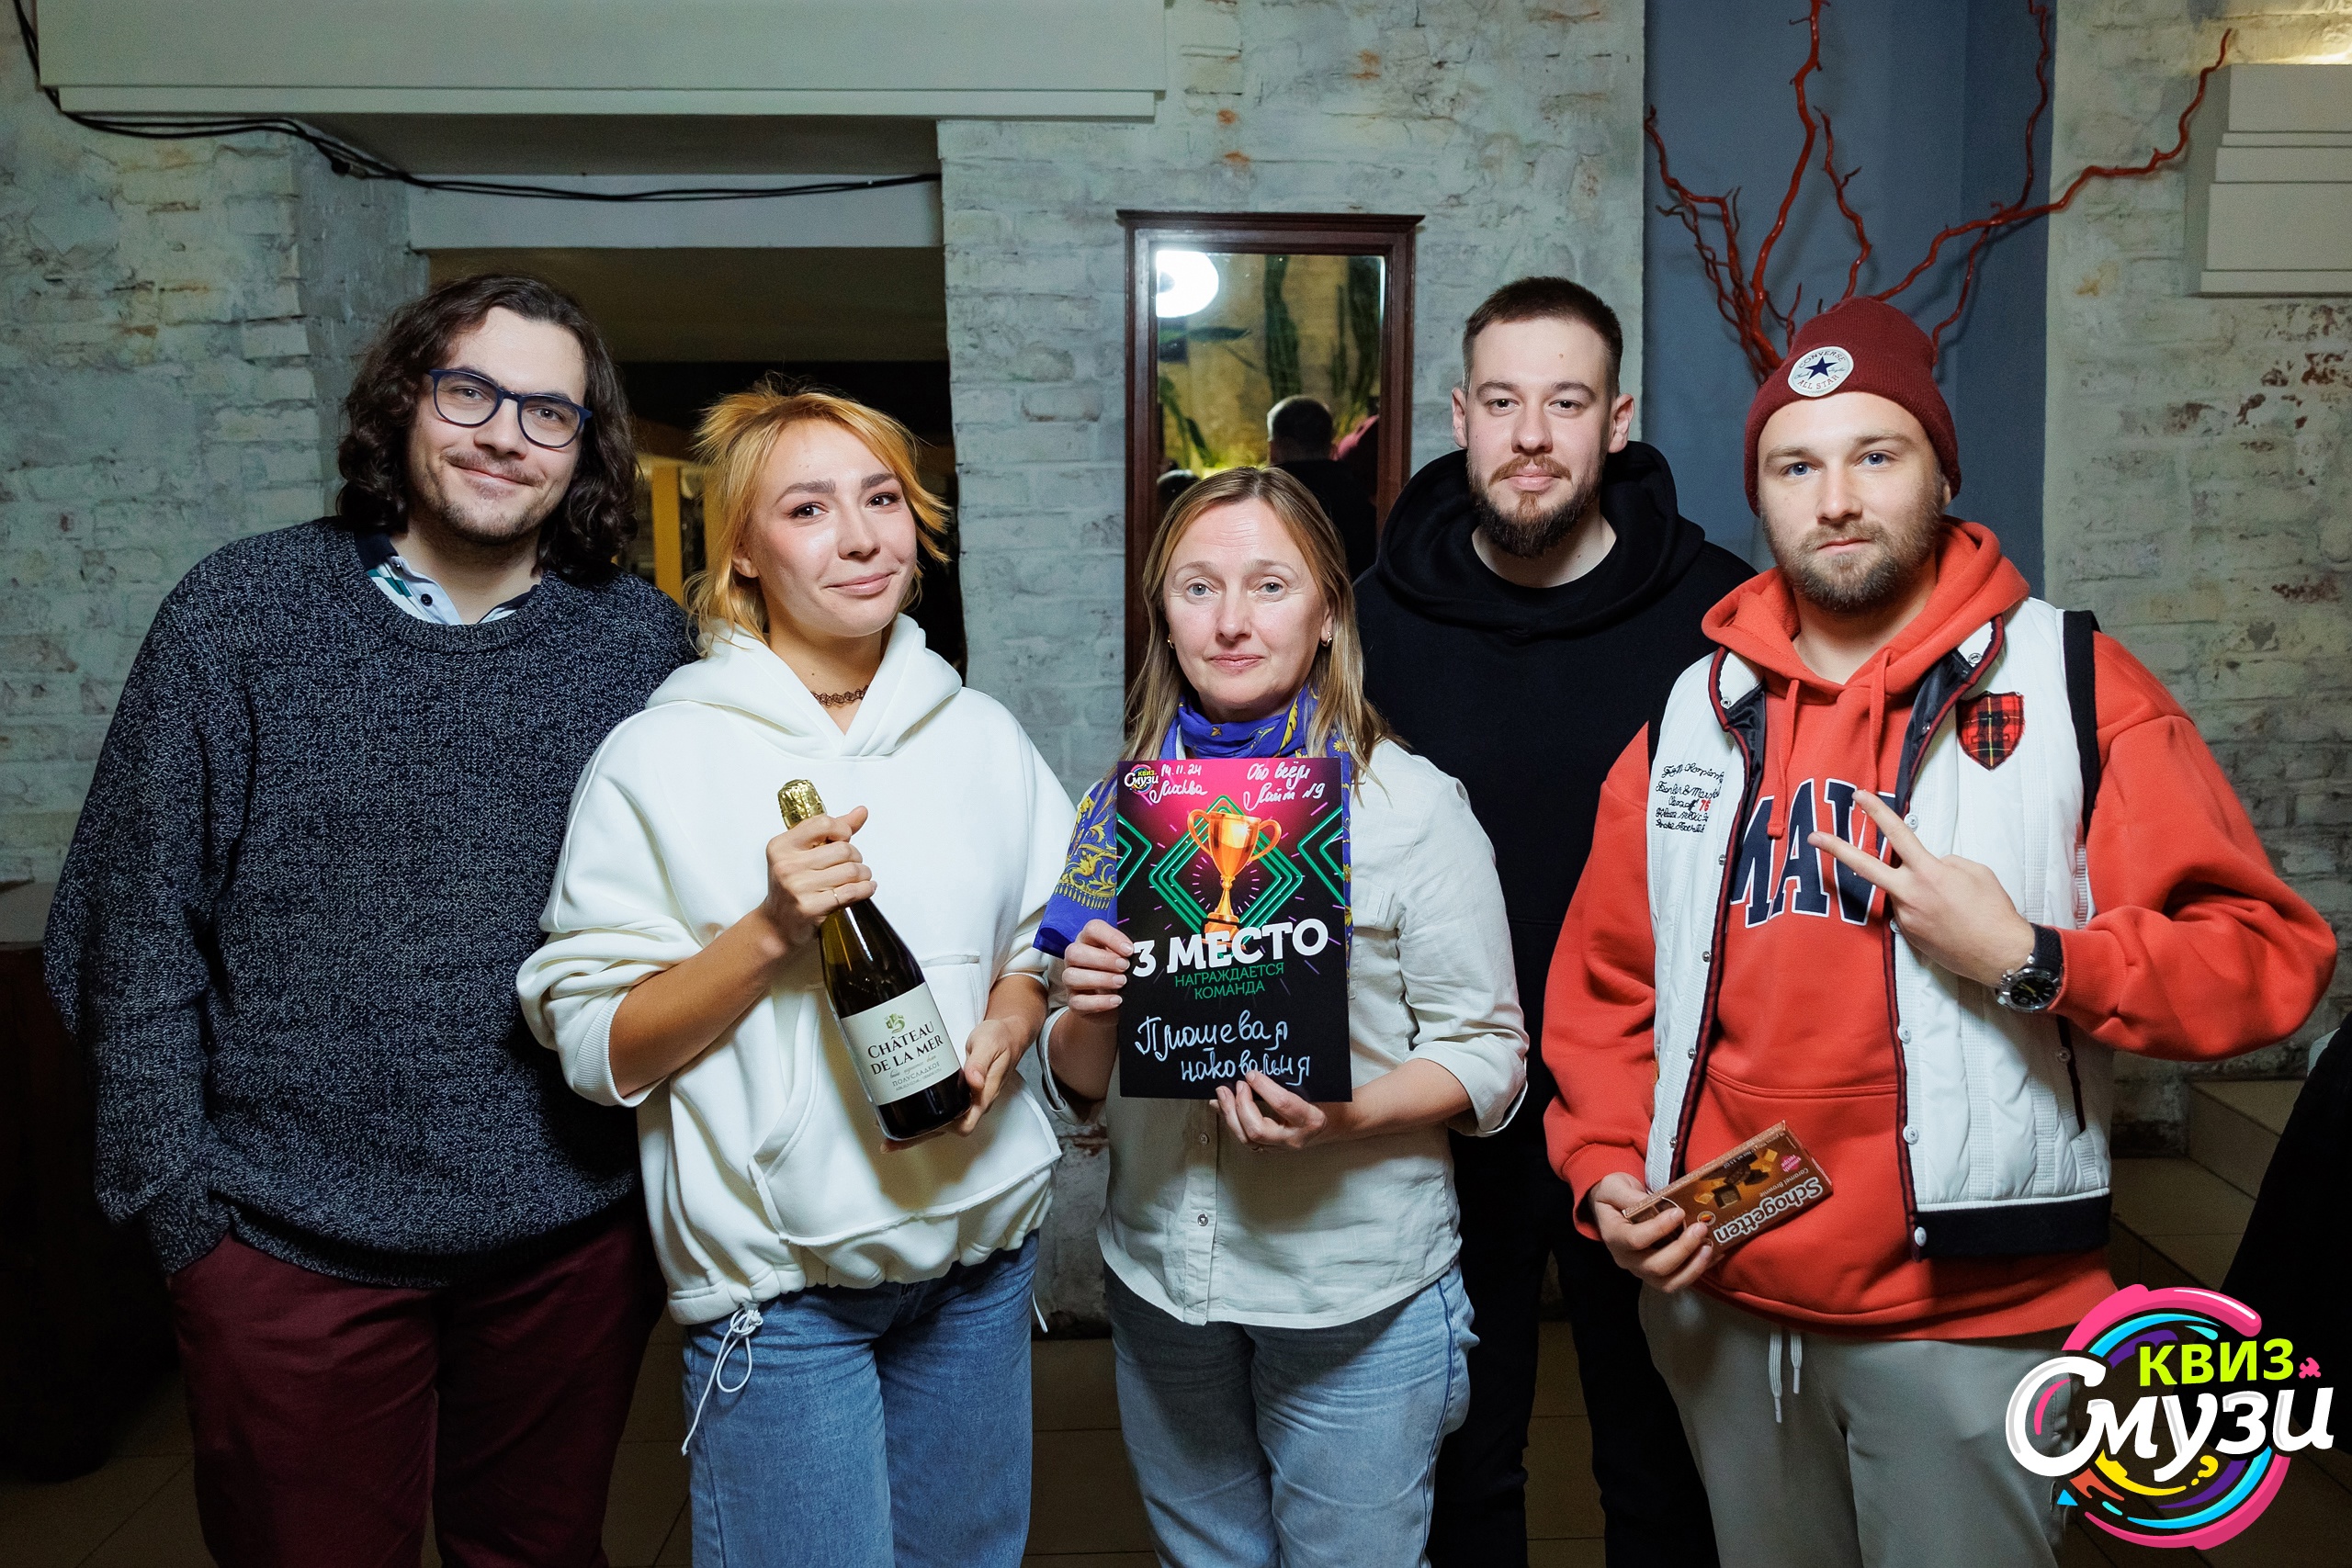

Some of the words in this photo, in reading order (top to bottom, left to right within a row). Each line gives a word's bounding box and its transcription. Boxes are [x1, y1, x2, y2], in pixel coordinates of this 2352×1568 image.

[1798, 351, 1846, 368] CONVERSE
[1798, 379, 1813, 389] ALL
[1815, 374, 1839, 389] STAR
[1124, 772, 1159, 788] Смузи
[1160, 763, 1203, 778] 14.11.24
[1132, 940, 1157, 977] 3
[1166, 918, 1329, 975] МЕСТО
[1175, 962, 1285, 988] НАГРАЖДАЕТСЯ
[1194, 980, 1266, 1000] КОМАНДА
[867, 1021, 935, 1059] CHÂTEAU
[870, 1059, 891, 1076] DE
[893, 1051, 914, 1067] LA
[916, 1034, 944, 1057] MER
[1784, 1168, 1809, 1186] Caramel
[1758, 1181, 1784, 1198] Brownie
[1713, 1177, 1824, 1244] Schogetten
